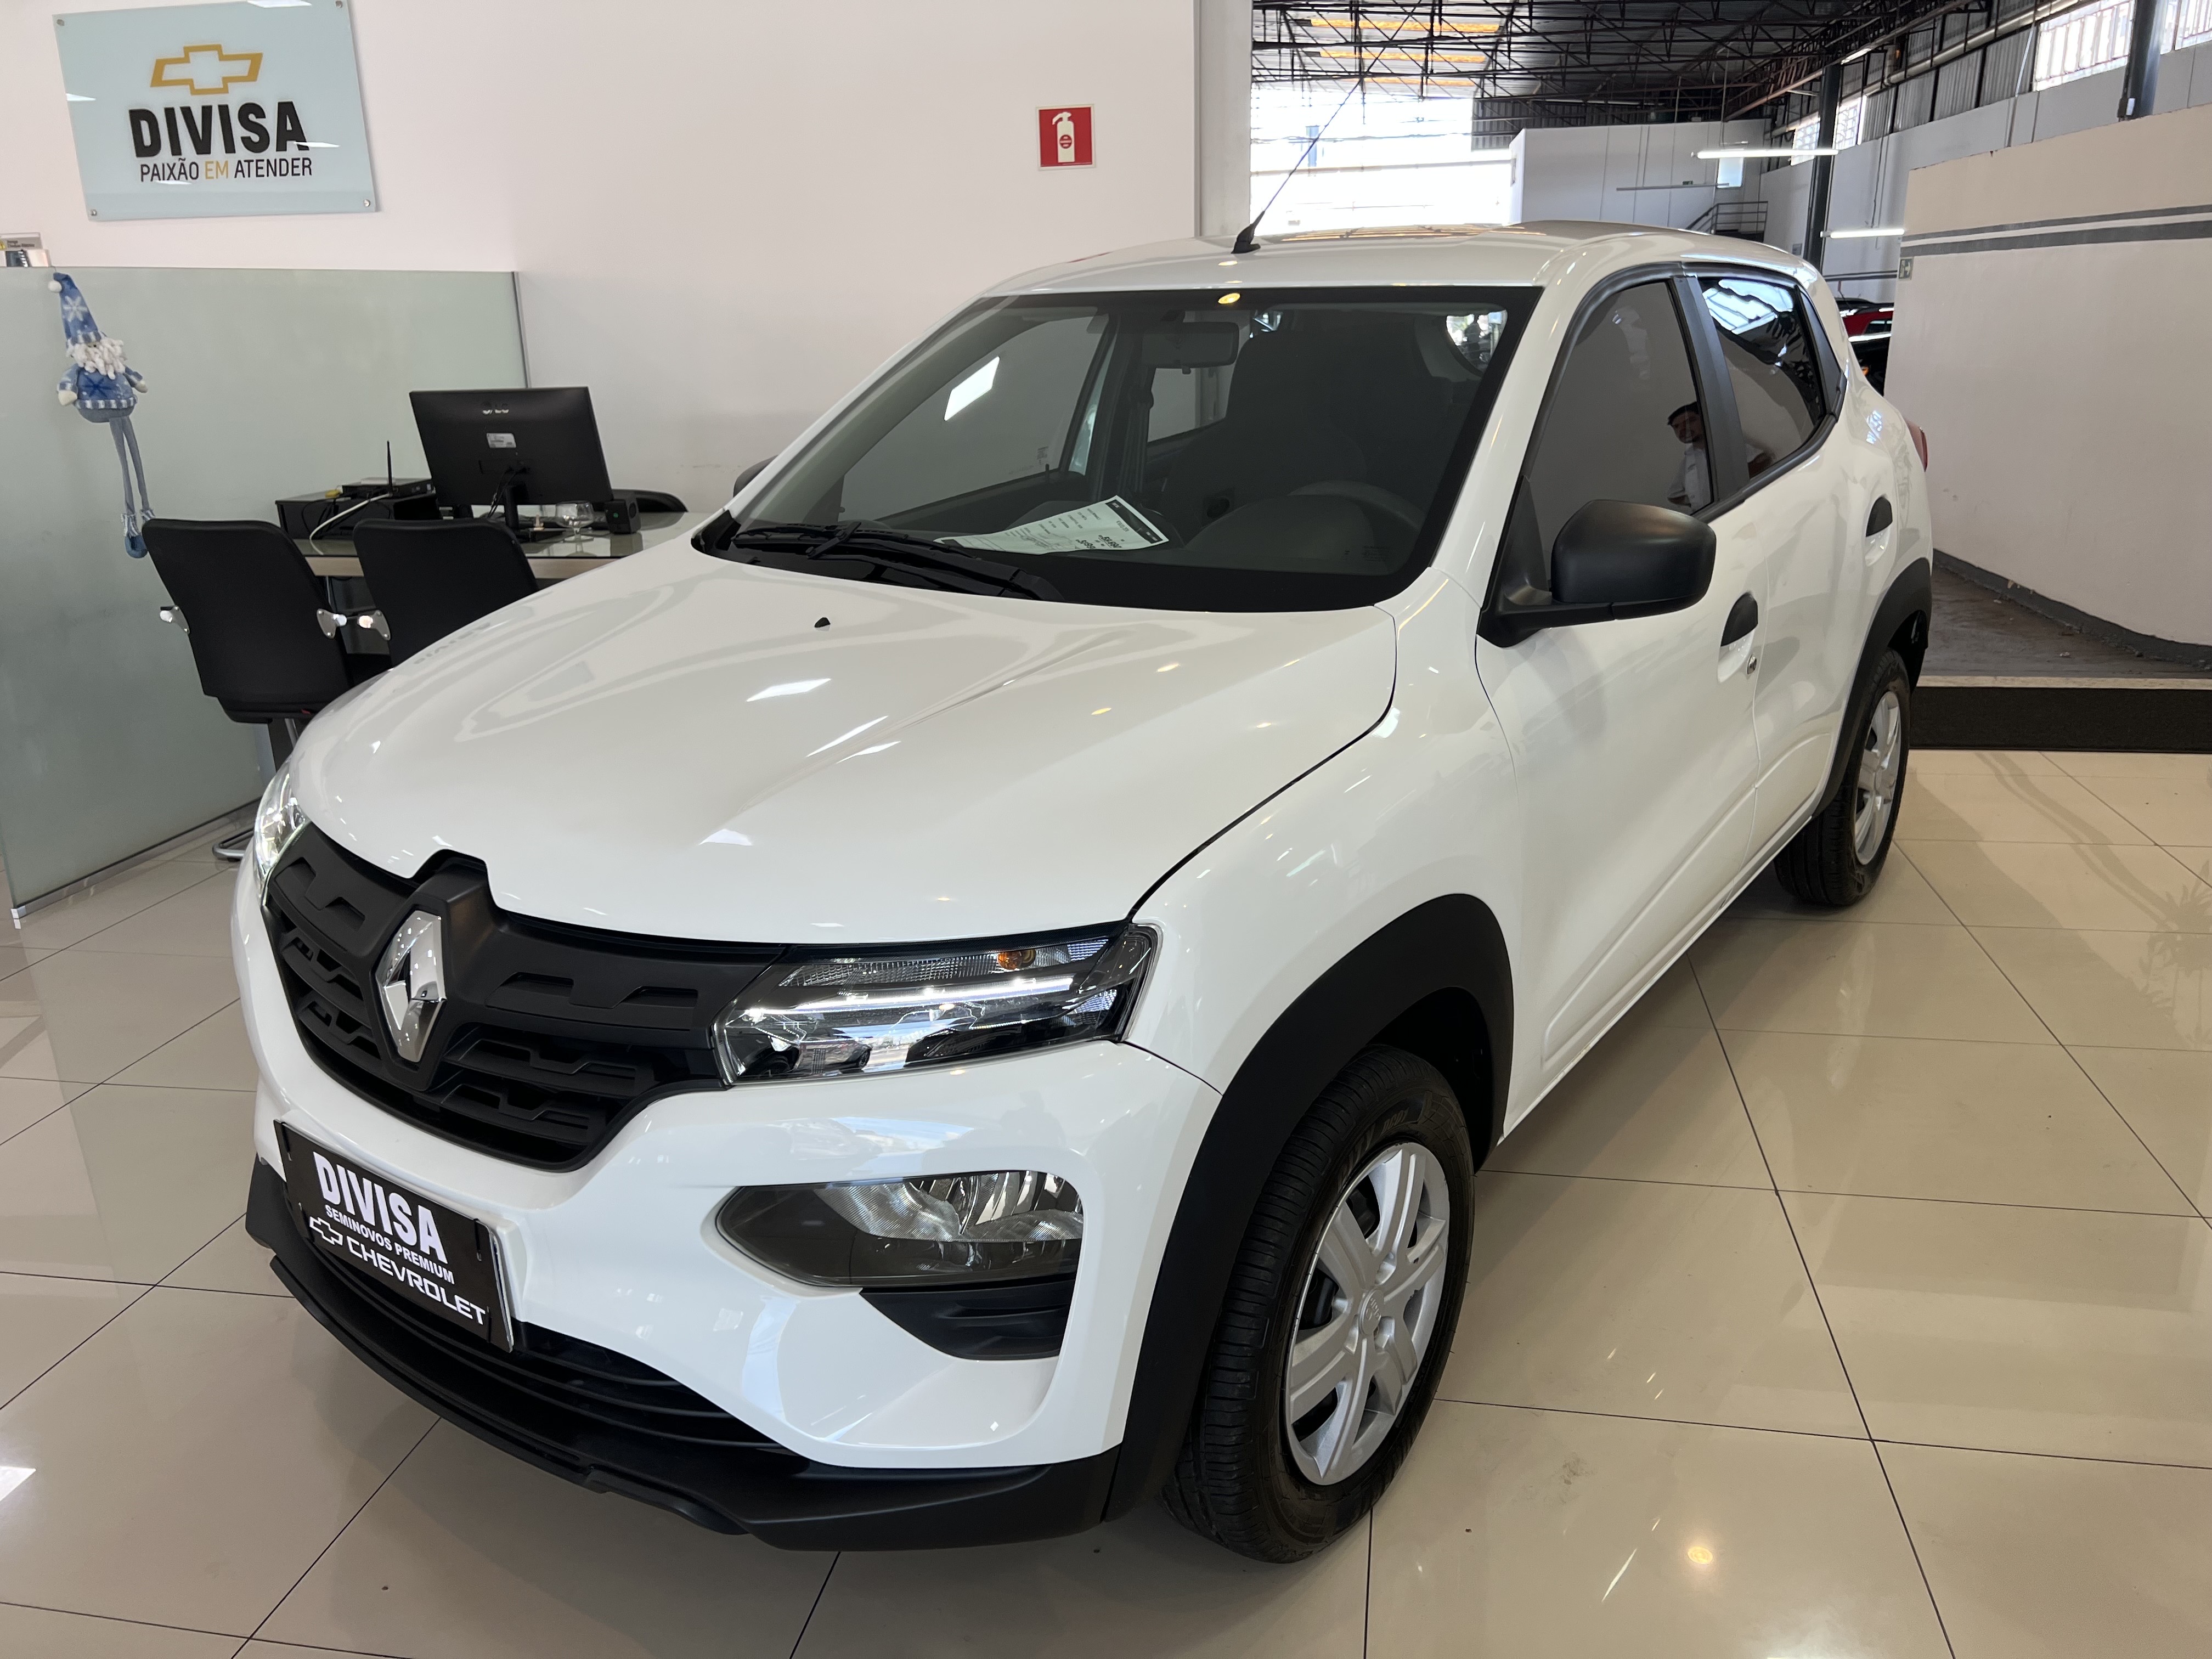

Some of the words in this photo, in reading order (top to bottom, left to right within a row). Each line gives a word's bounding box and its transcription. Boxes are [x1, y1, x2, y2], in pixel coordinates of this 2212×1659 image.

[128, 101, 309, 157] DIVISA
[140, 158, 199, 182] PAIXÃO
[205, 160, 228, 179] EM
[234, 157, 312, 178] ATENDER
[313, 1152, 448, 1264] DIVISA
[325, 1204, 392, 1251] SEMINOVOS
[394, 1243, 455, 1285] PREMIUM
[346, 1235, 486, 1325] CHEVROLET
